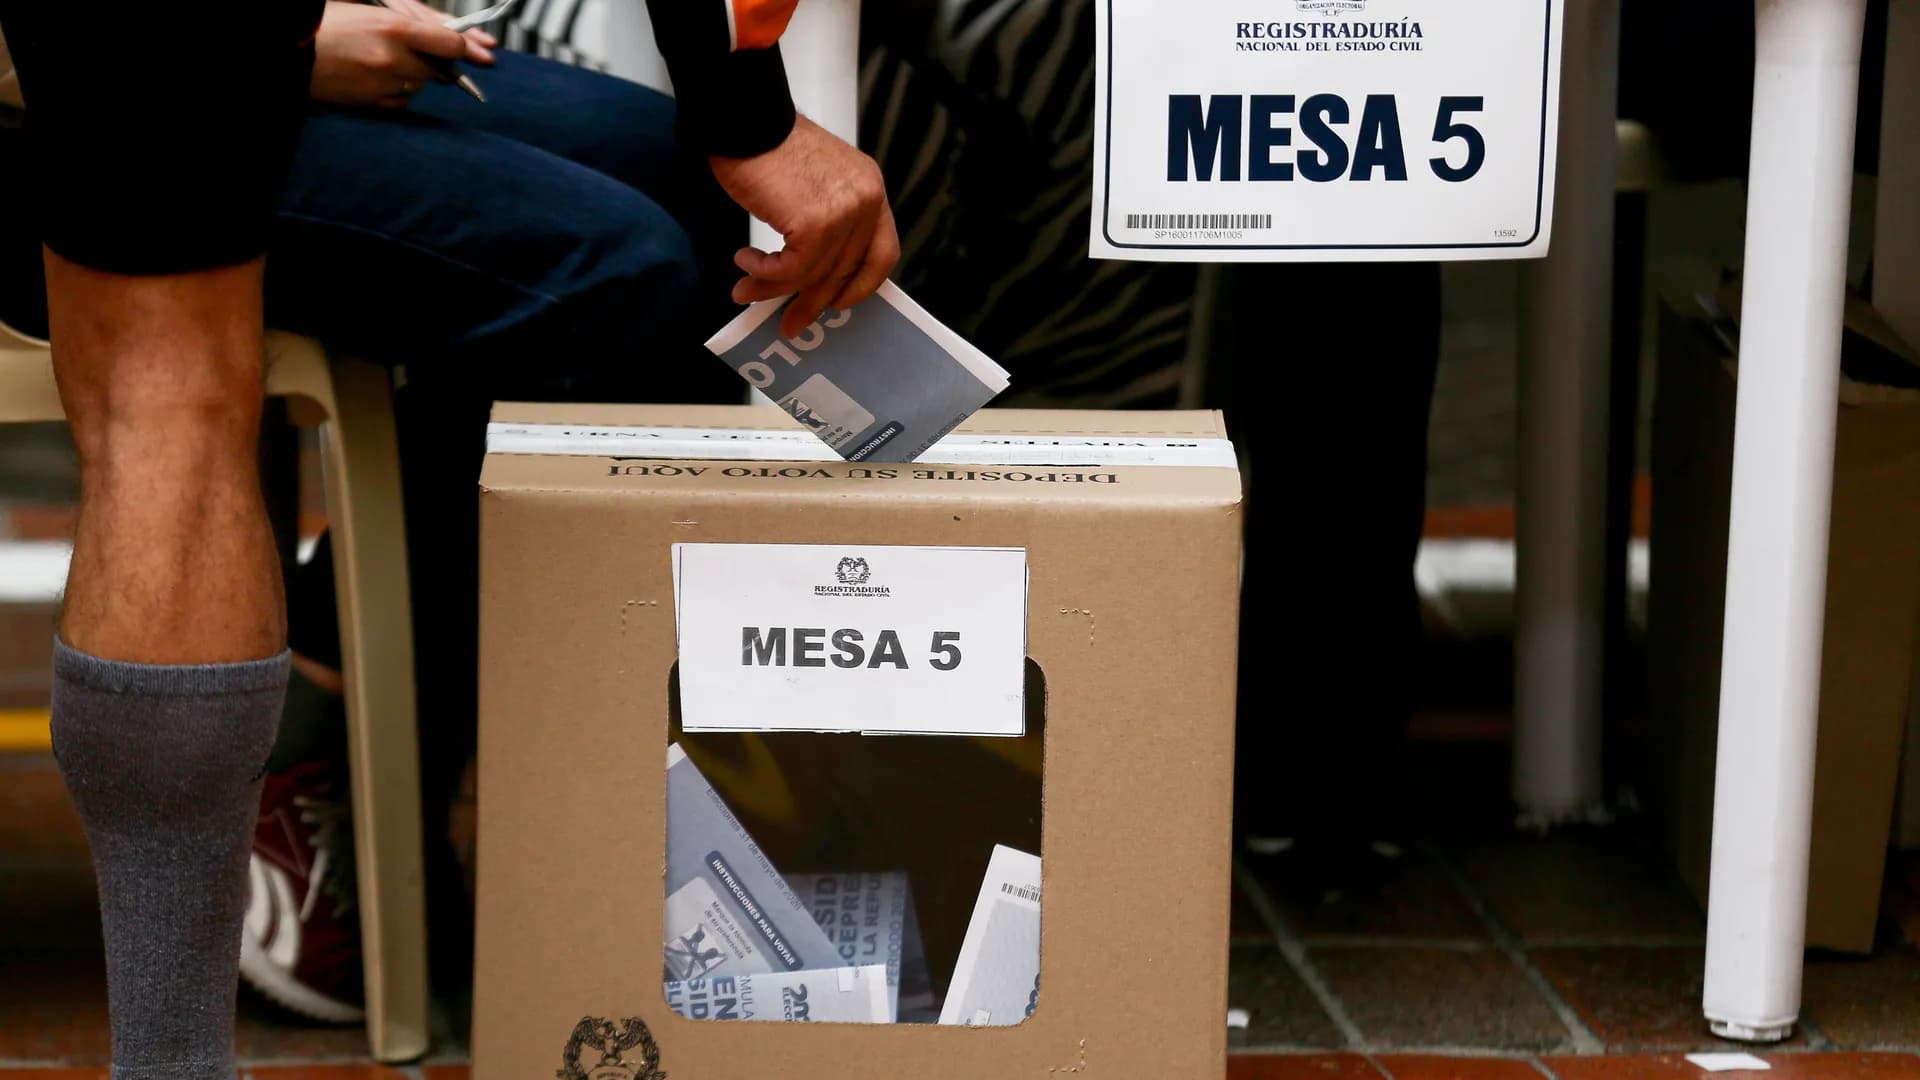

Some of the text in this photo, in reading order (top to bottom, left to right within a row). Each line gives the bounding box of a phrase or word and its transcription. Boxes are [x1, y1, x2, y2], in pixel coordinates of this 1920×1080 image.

[1236, 16, 1424, 39] REGISTRADURÍA
[1236, 42, 1423, 51] NACIONAL DEL ESTADO CIVIL
[1166, 92, 1486, 183] MESA 5
[721, 467, 834, 479] VOTO
[845, 468, 898, 480] SU
[913, 470, 1120, 484] DEPOSITE
[814, 585, 890, 594] REGISTRADURÍA
[741, 626, 962, 671] MESA 5
[712, 858, 795, 967] INSTRUCCIONES PARA VOTAR
